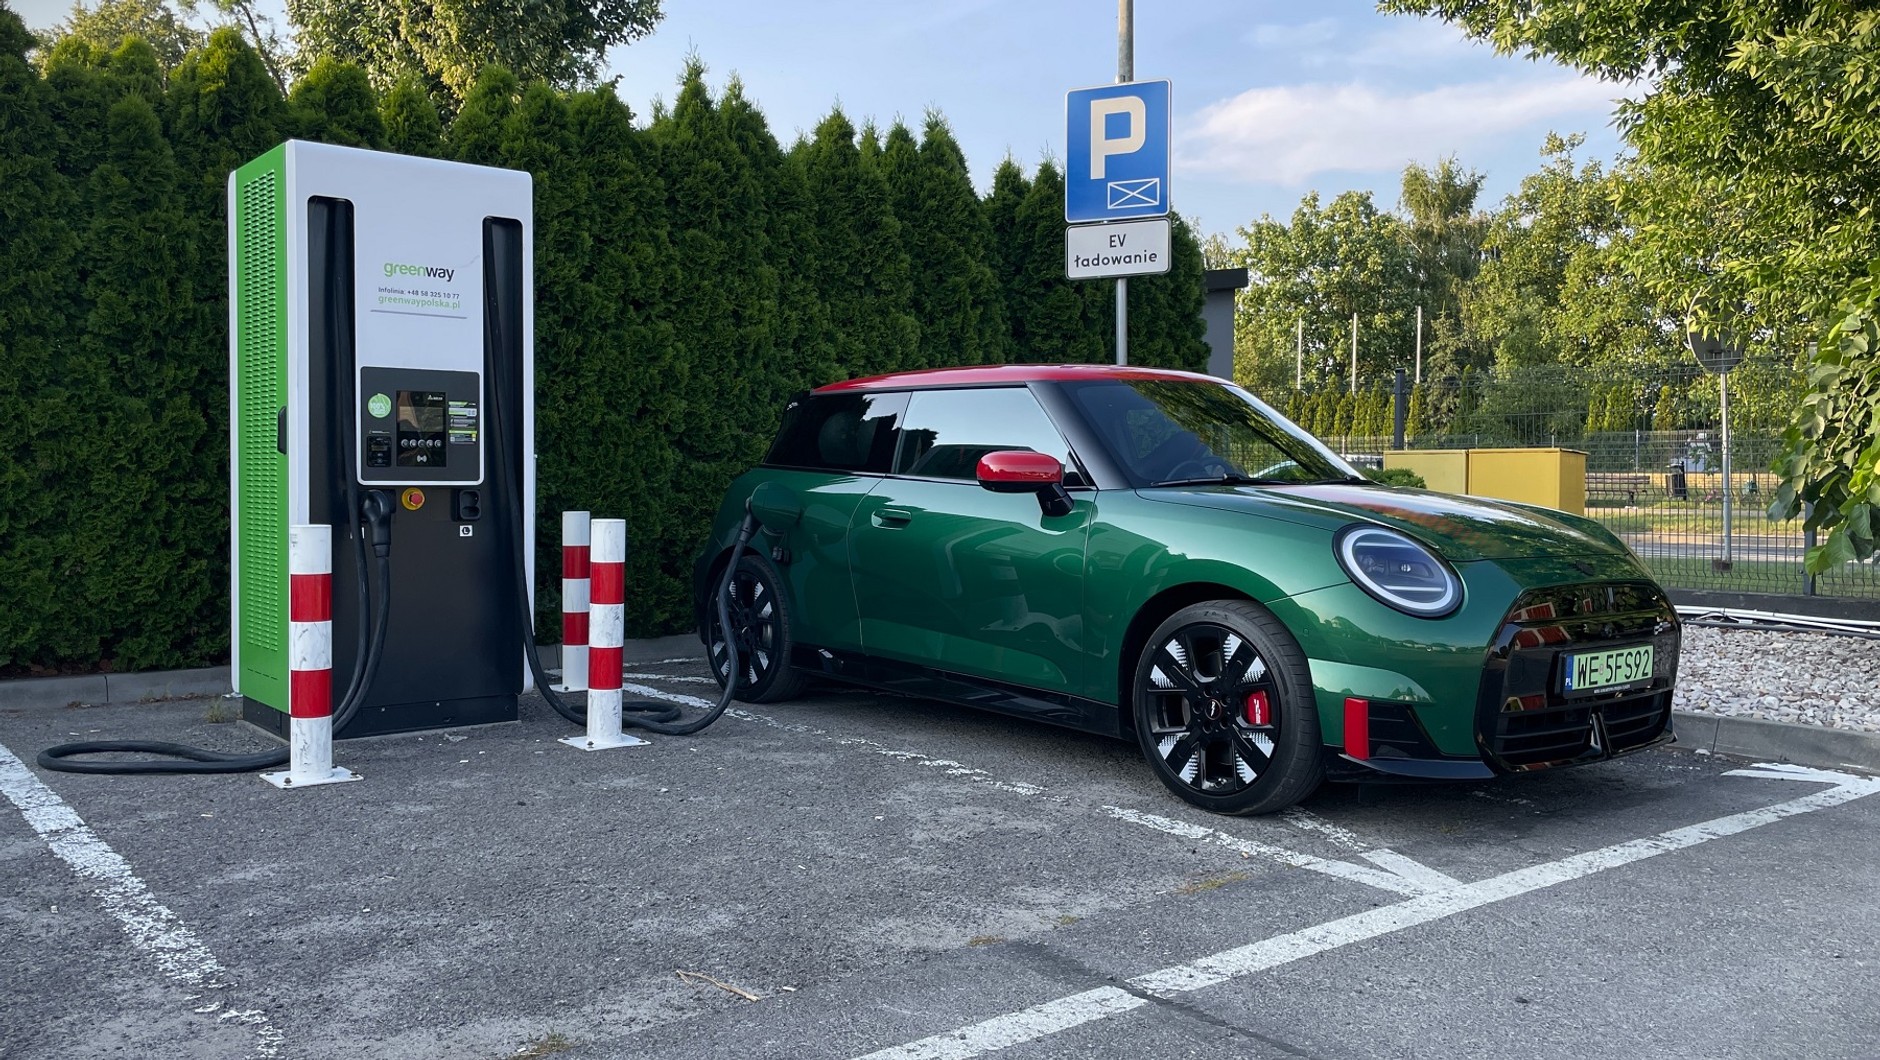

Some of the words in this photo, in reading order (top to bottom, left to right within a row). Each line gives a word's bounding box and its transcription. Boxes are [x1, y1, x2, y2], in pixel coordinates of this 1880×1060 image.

[1090, 95, 1146, 180] P
[1109, 234, 1126, 248] EV
[1074, 250, 1158, 268] ładowanie
[384, 262, 455, 282] greenway
[378, 295, 461, 309] greenwaypolska.pl
[1577, 656, 1599, 687] WE
[1605, 649, 1650, 683] 5FS92
[1565, 677, 1572, 687] PL
